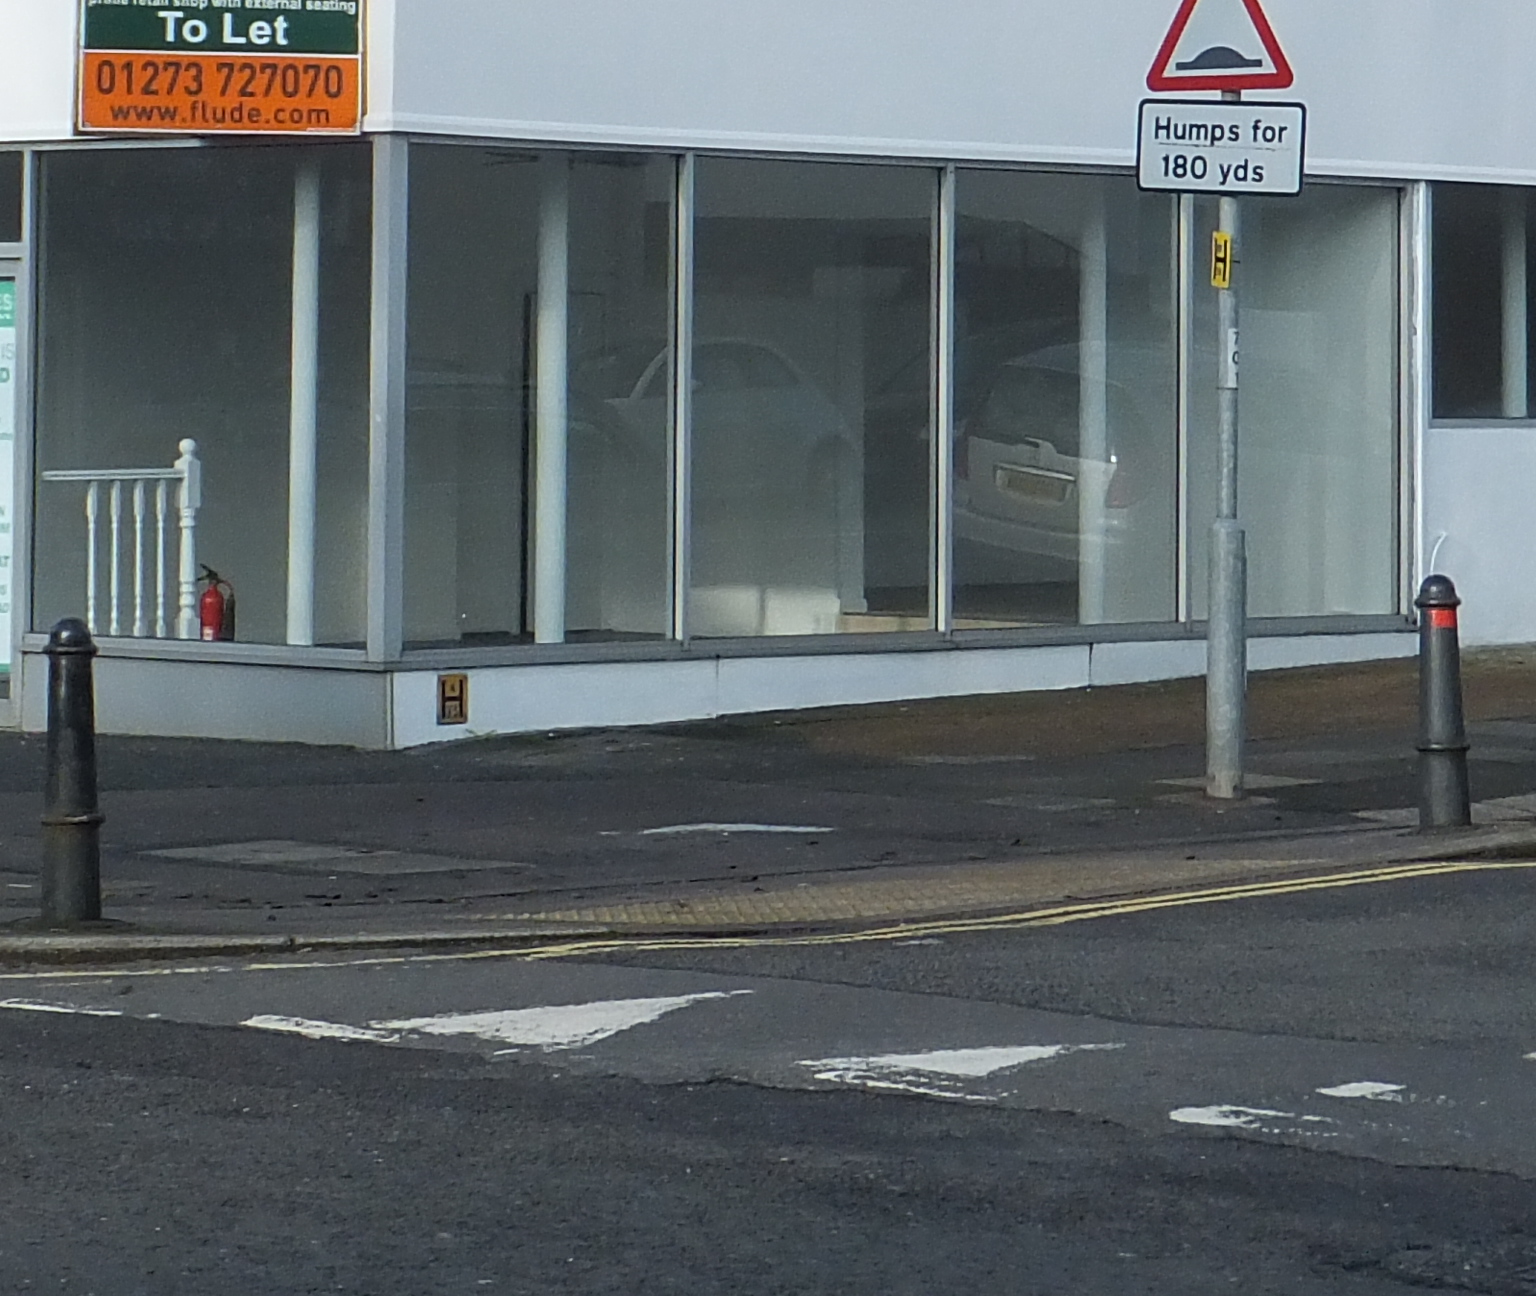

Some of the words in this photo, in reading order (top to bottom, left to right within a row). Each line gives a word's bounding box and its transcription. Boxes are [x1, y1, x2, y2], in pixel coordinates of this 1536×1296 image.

[306, 0, 356, 15] seating
[158, 11, 207, 43] To
[222, 13, 289, 45] Let
[97, 60, 203, 95] 01273
[216, 63, 343, 98] 727070
[110, 101, 329, 125] www.flude.com
[1154, 116, 1240, 147] Humps
[1252, 120, 1288, 143] for
[1162, 154, 1207, 179] 180
[1219, 159, 1264, 185] yds
[1, 343, 15, 360] IS
